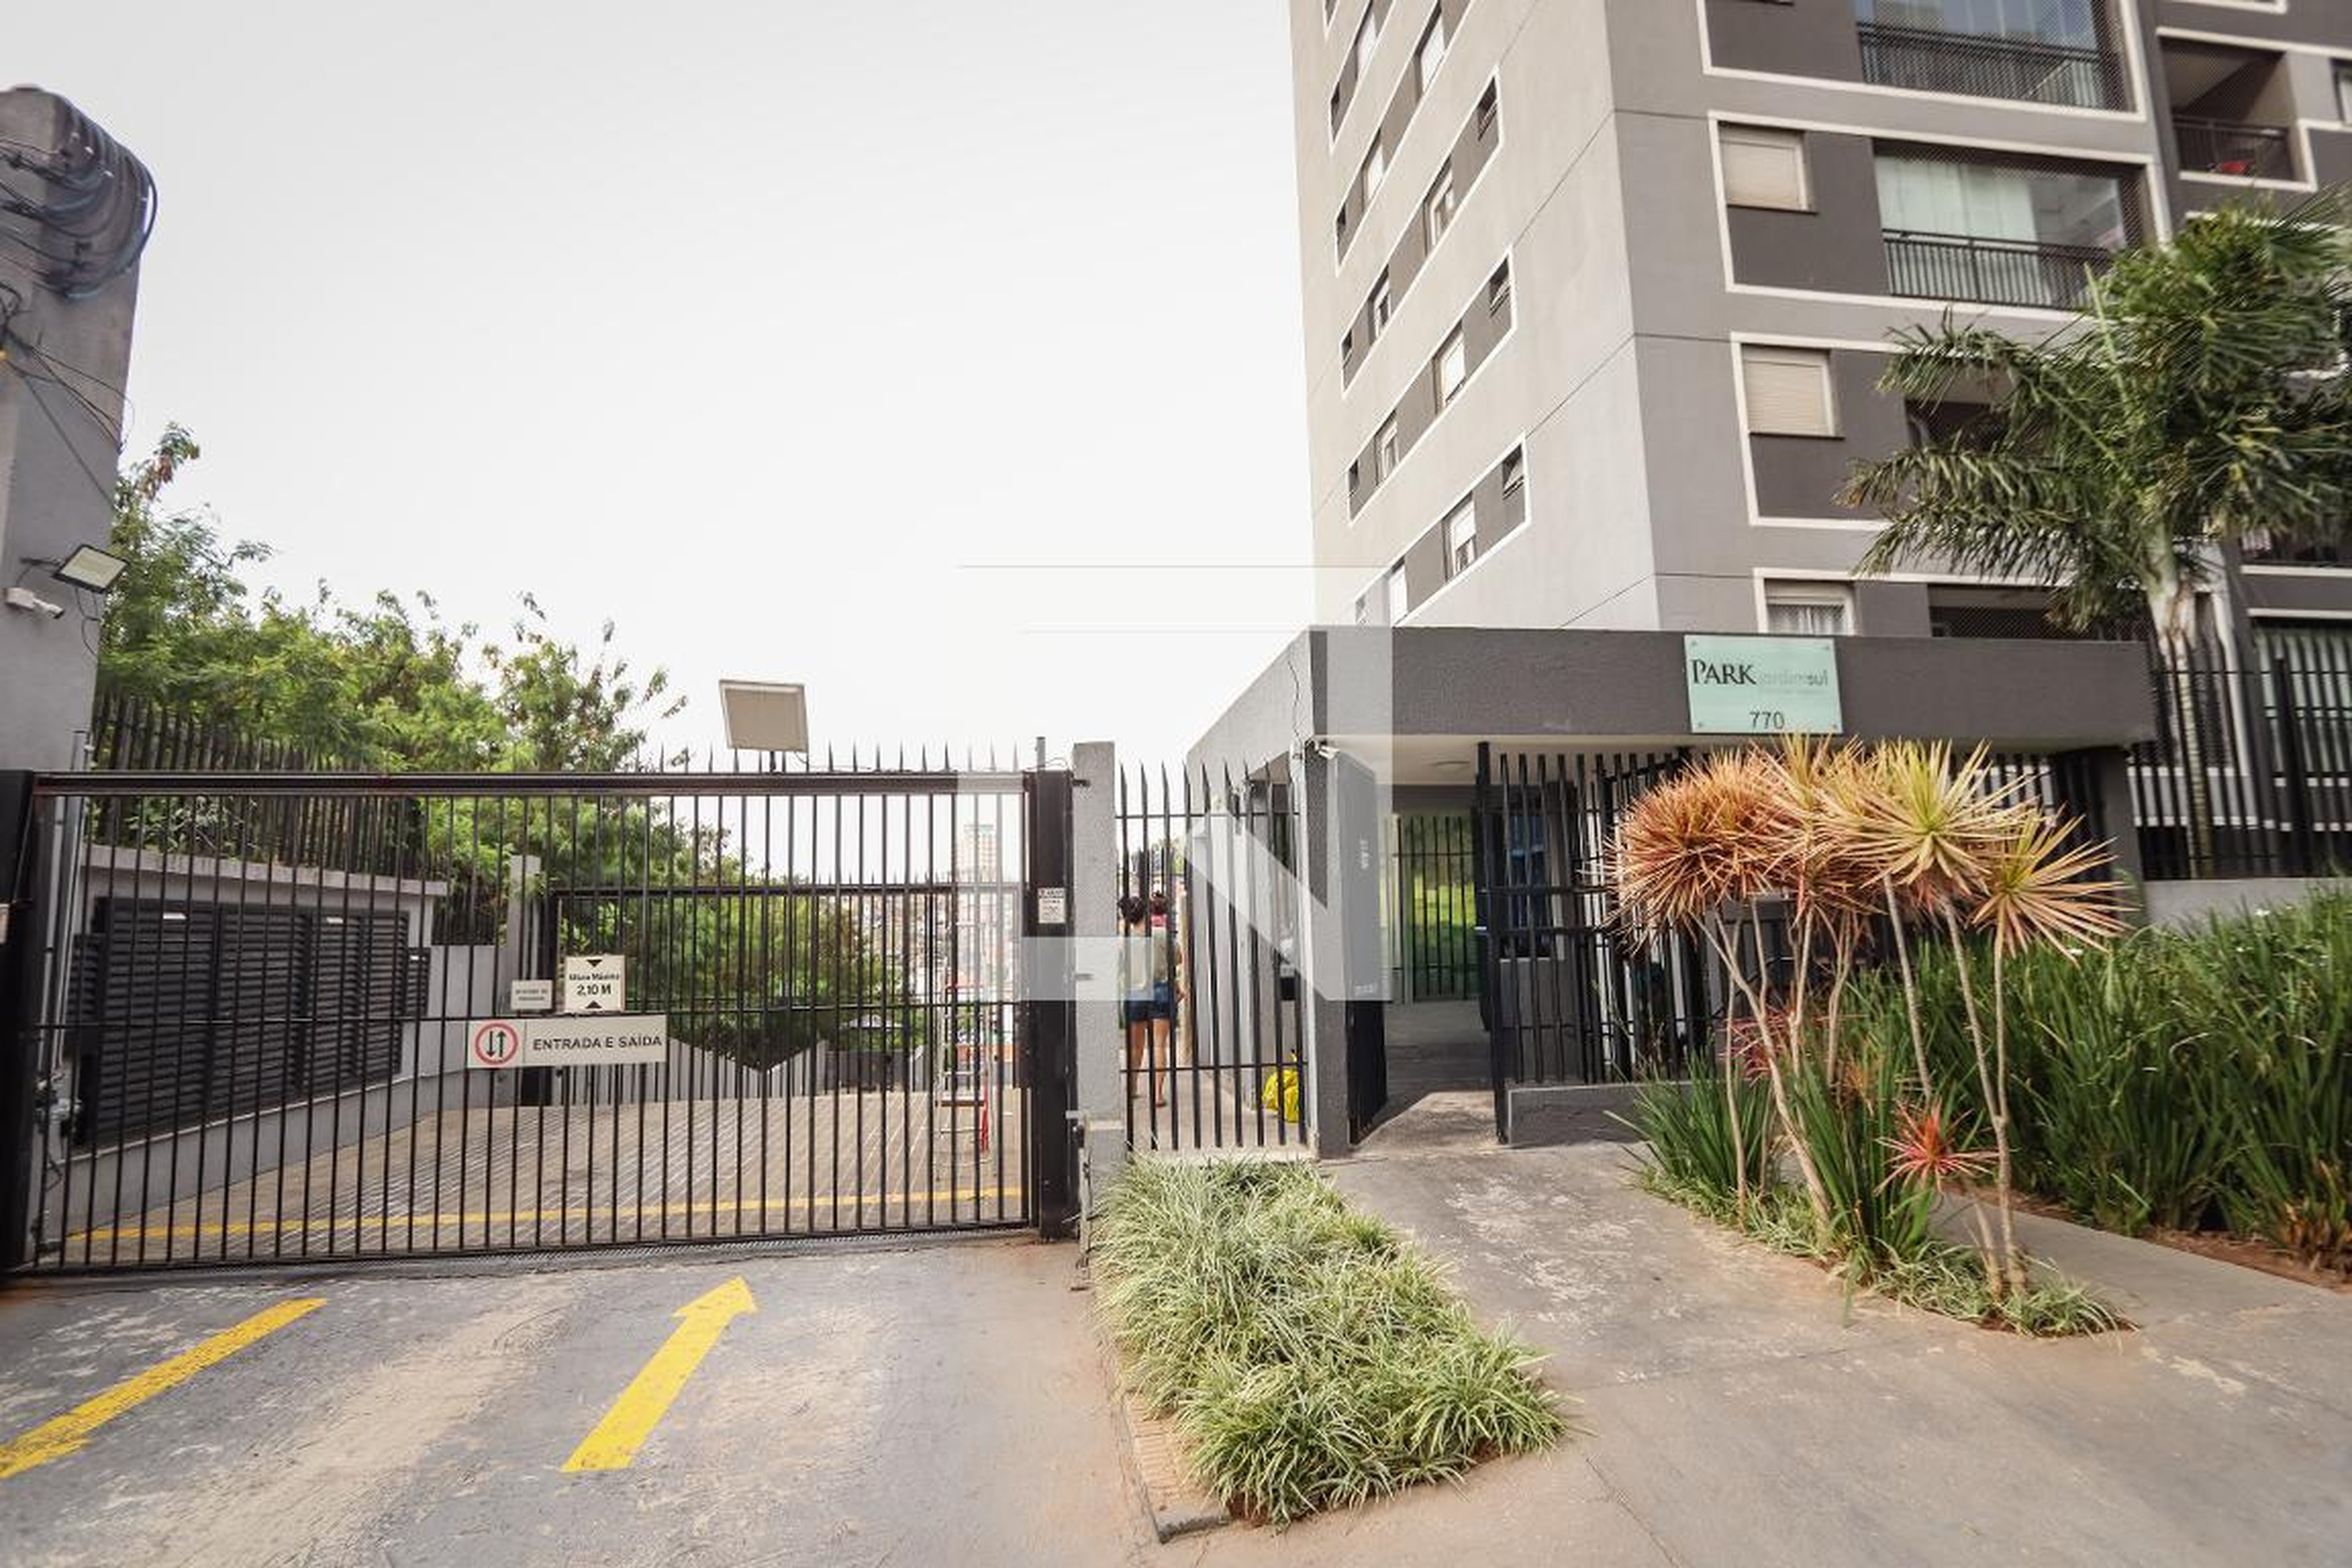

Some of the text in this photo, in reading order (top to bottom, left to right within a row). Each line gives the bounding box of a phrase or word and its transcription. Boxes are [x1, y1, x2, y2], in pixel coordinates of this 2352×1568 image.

[1691, 659, 1757, 685] PARK
[1749, 712, 1785, 729] 770
[577, 984, 611, 996] 2,10 M
[533, 1038, 601, 1050] ENTRADA
[606, 1036, 614, 1048] E
